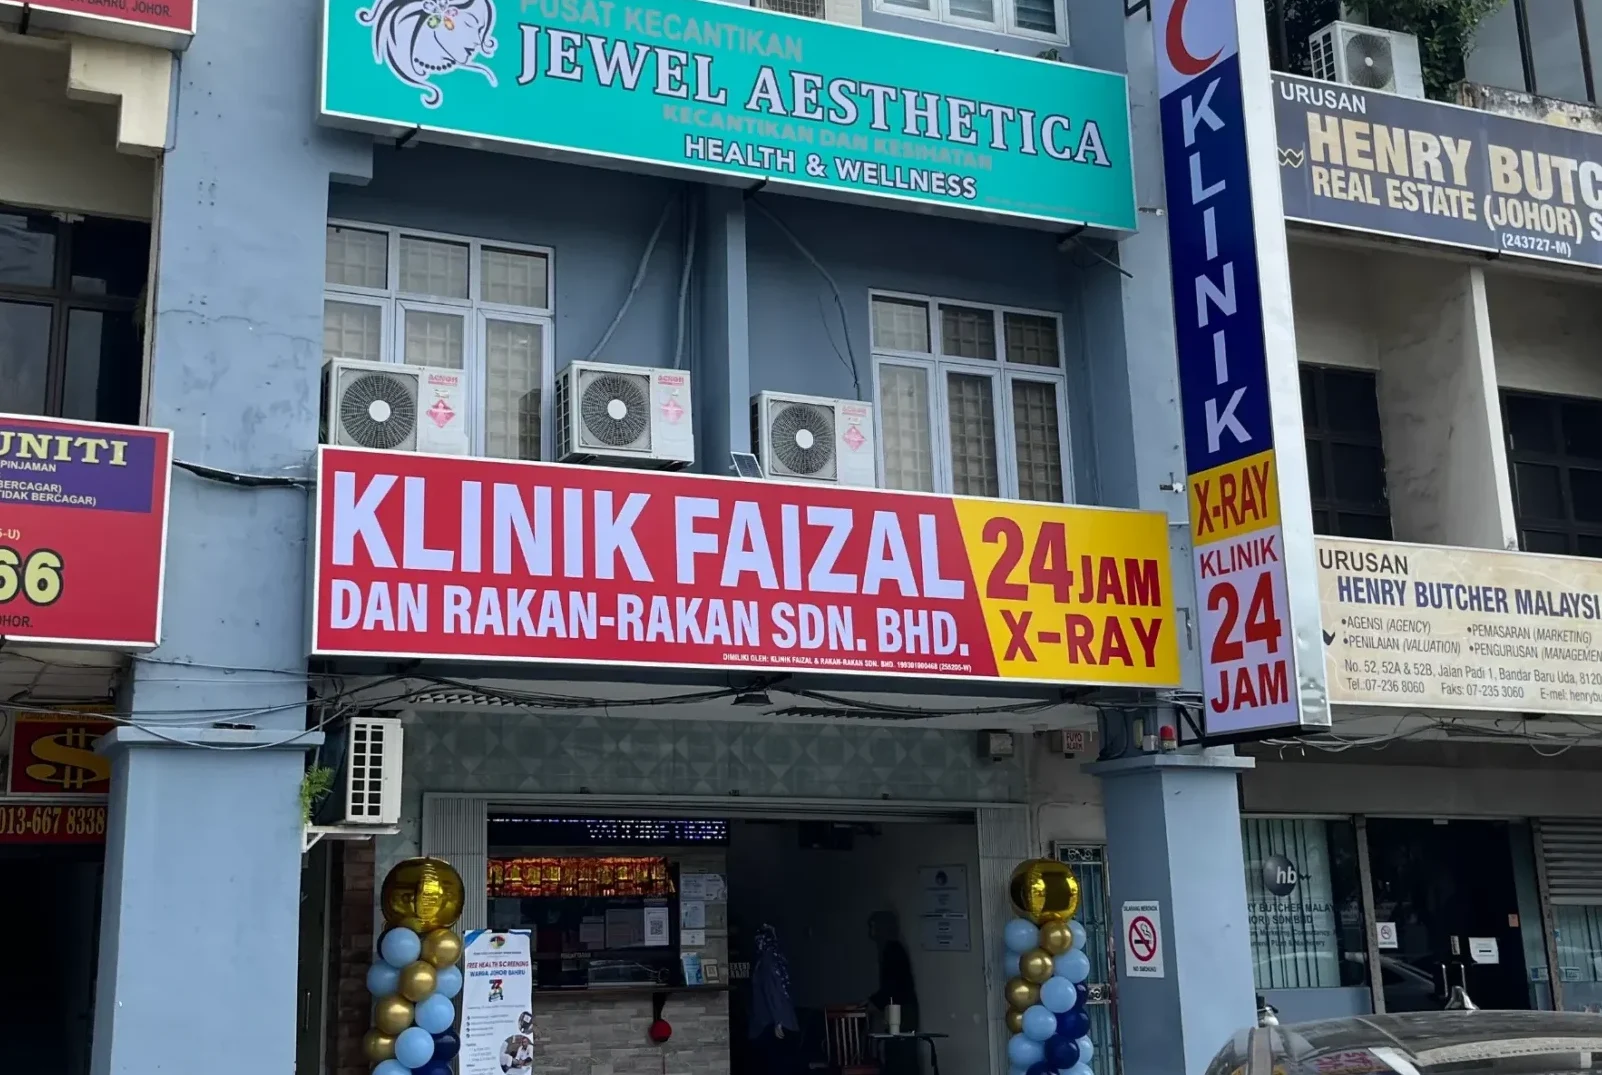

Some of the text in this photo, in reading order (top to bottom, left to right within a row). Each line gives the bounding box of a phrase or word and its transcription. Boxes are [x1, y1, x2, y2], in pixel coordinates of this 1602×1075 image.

[520, 0, 802, 62] PUSAT KECANTIKAN
[516, 22, 1113, 168] JEWEL AESTHETICA
[1280, 82, 1367, 114] URUSAN
[663, 103, 814, 144] KECANTIKAN
[817, 129, 868, 151] DAN
[684, 133, 977, 200] HEALTH & WELLNESS
[1306, 111, 1602, 210] HENRY BUTC
[1311, 165, 1380, 206] REAL
[1385, 177, 1477, 221] ESTATE
[1484, 194, 1583, 245] (JOHOR)
[1501, 231, 1572, 259] (243727-M)
[1181, 76, 1253, 455] KLINIK
[0, 461, 57, 473] PINJAMAN
[31, 492, 97, 507] BERCAGAR)
[1194, 460, 1270, 537] X-RAY
[332, 470, 965, 600] KLINIK FAIZAL
[982, 516, 1161, 607] 24 JAM
[1200, 534, 1278, 579] KLINIK
[1318, 549, 1409, 575] URUSAN
[1337, 575, 1602, 620] HENRY BUTCHER MALAYSI
[330, 579, 969, 657] DAN RAKAN-RAKAN SDN. BHD.
[1207, 571, 1282, 665] 24
[1347, 616, 1431, 635] AGENSI (AGENCY)
[999, 609, 1163, 668] X-RAY
[1348, 635, 1461, 655] PENILAIAN (VALUATION)
[1472, 623, 1592, 645] PEMASARAN (MARKETING)
[770, 655, 791, 663] KLINIK
[792, 656, 812, 664] FAIZAL
[1474, 642, 1538, 659] PENGURUSAN
[1210, 660, 1289, 714] JAM
[1344, 659, 1361, 673] No.
[1364, 660, 1380, 675] 52,
[1382, 661, 1401, 675] 52A
[1403, 662, 1411, 675] &
[1413, 663, 1436, 678] 52B,
[1438, 665, 1463, 678] Jalan
[1465, 665, 1486, 679] Padi
[1499, 667, 1531, 682] Bandar
[1534, 669, 1555, 683] Baru
[1557, 671, 1578, 686] Uda,
[1402, 680, 1425, 694] 8060
[1441, 682, 1464, 696] Faks:
[1466, 684, 1499, 698] 07-235
[1502, 685, 1525, 699] 3060
[1066, 732, 1082, 741] FUYO
[1066, 742, 1083, 750] ALARM
[66, 807, 105, 835] 8338
[1276, 866, 1297, 885] hb
[1259, 902, 1302, 912] BUTCHER
[467, 960, 529, 969] FREE HEALTH SCREENING
